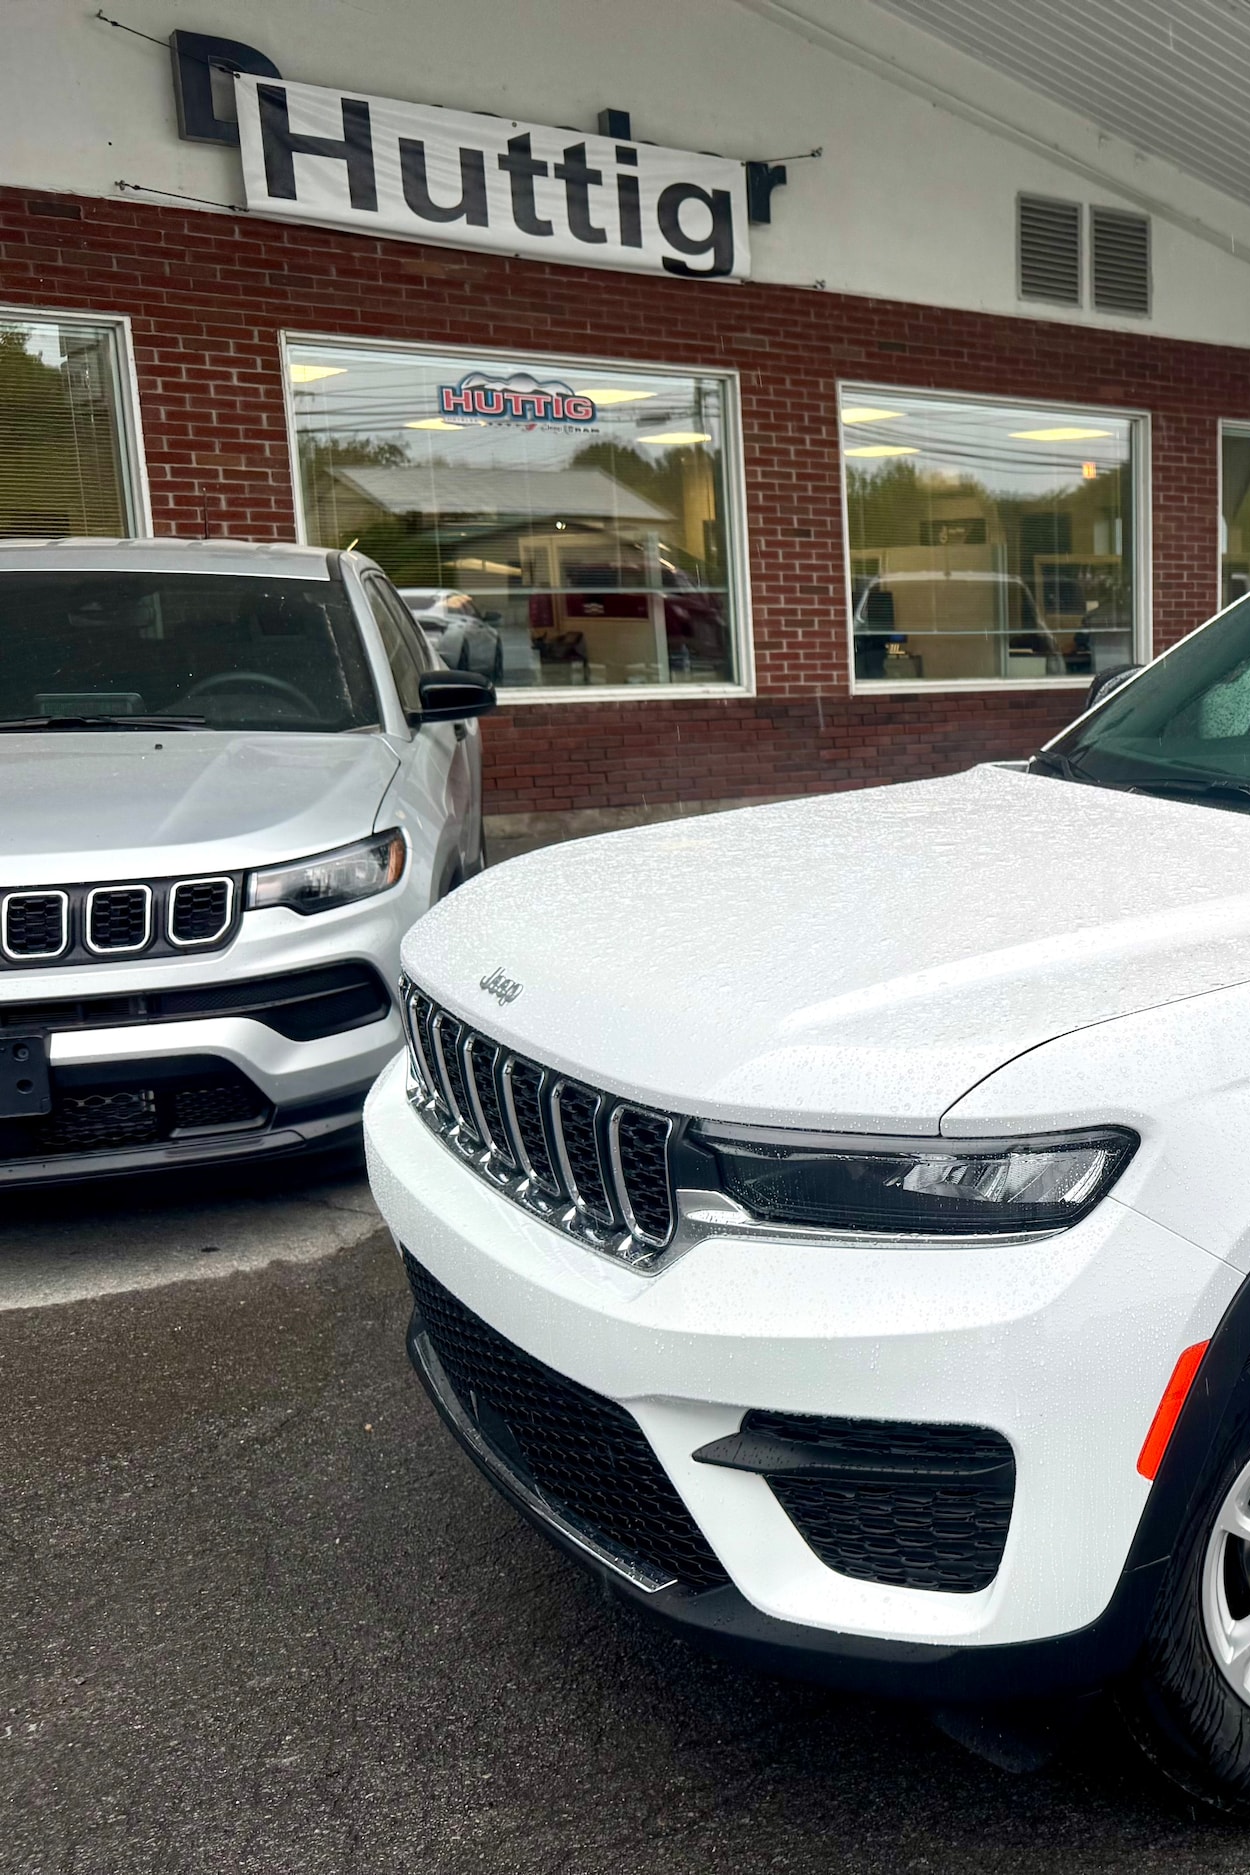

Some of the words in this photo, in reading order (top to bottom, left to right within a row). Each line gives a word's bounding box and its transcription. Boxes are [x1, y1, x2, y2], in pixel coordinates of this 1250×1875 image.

[254, 82, 736, 278] Huttig
[442, 388, 594, 420] HUTTIG
[480, 966, 524, 1007] Jeep
